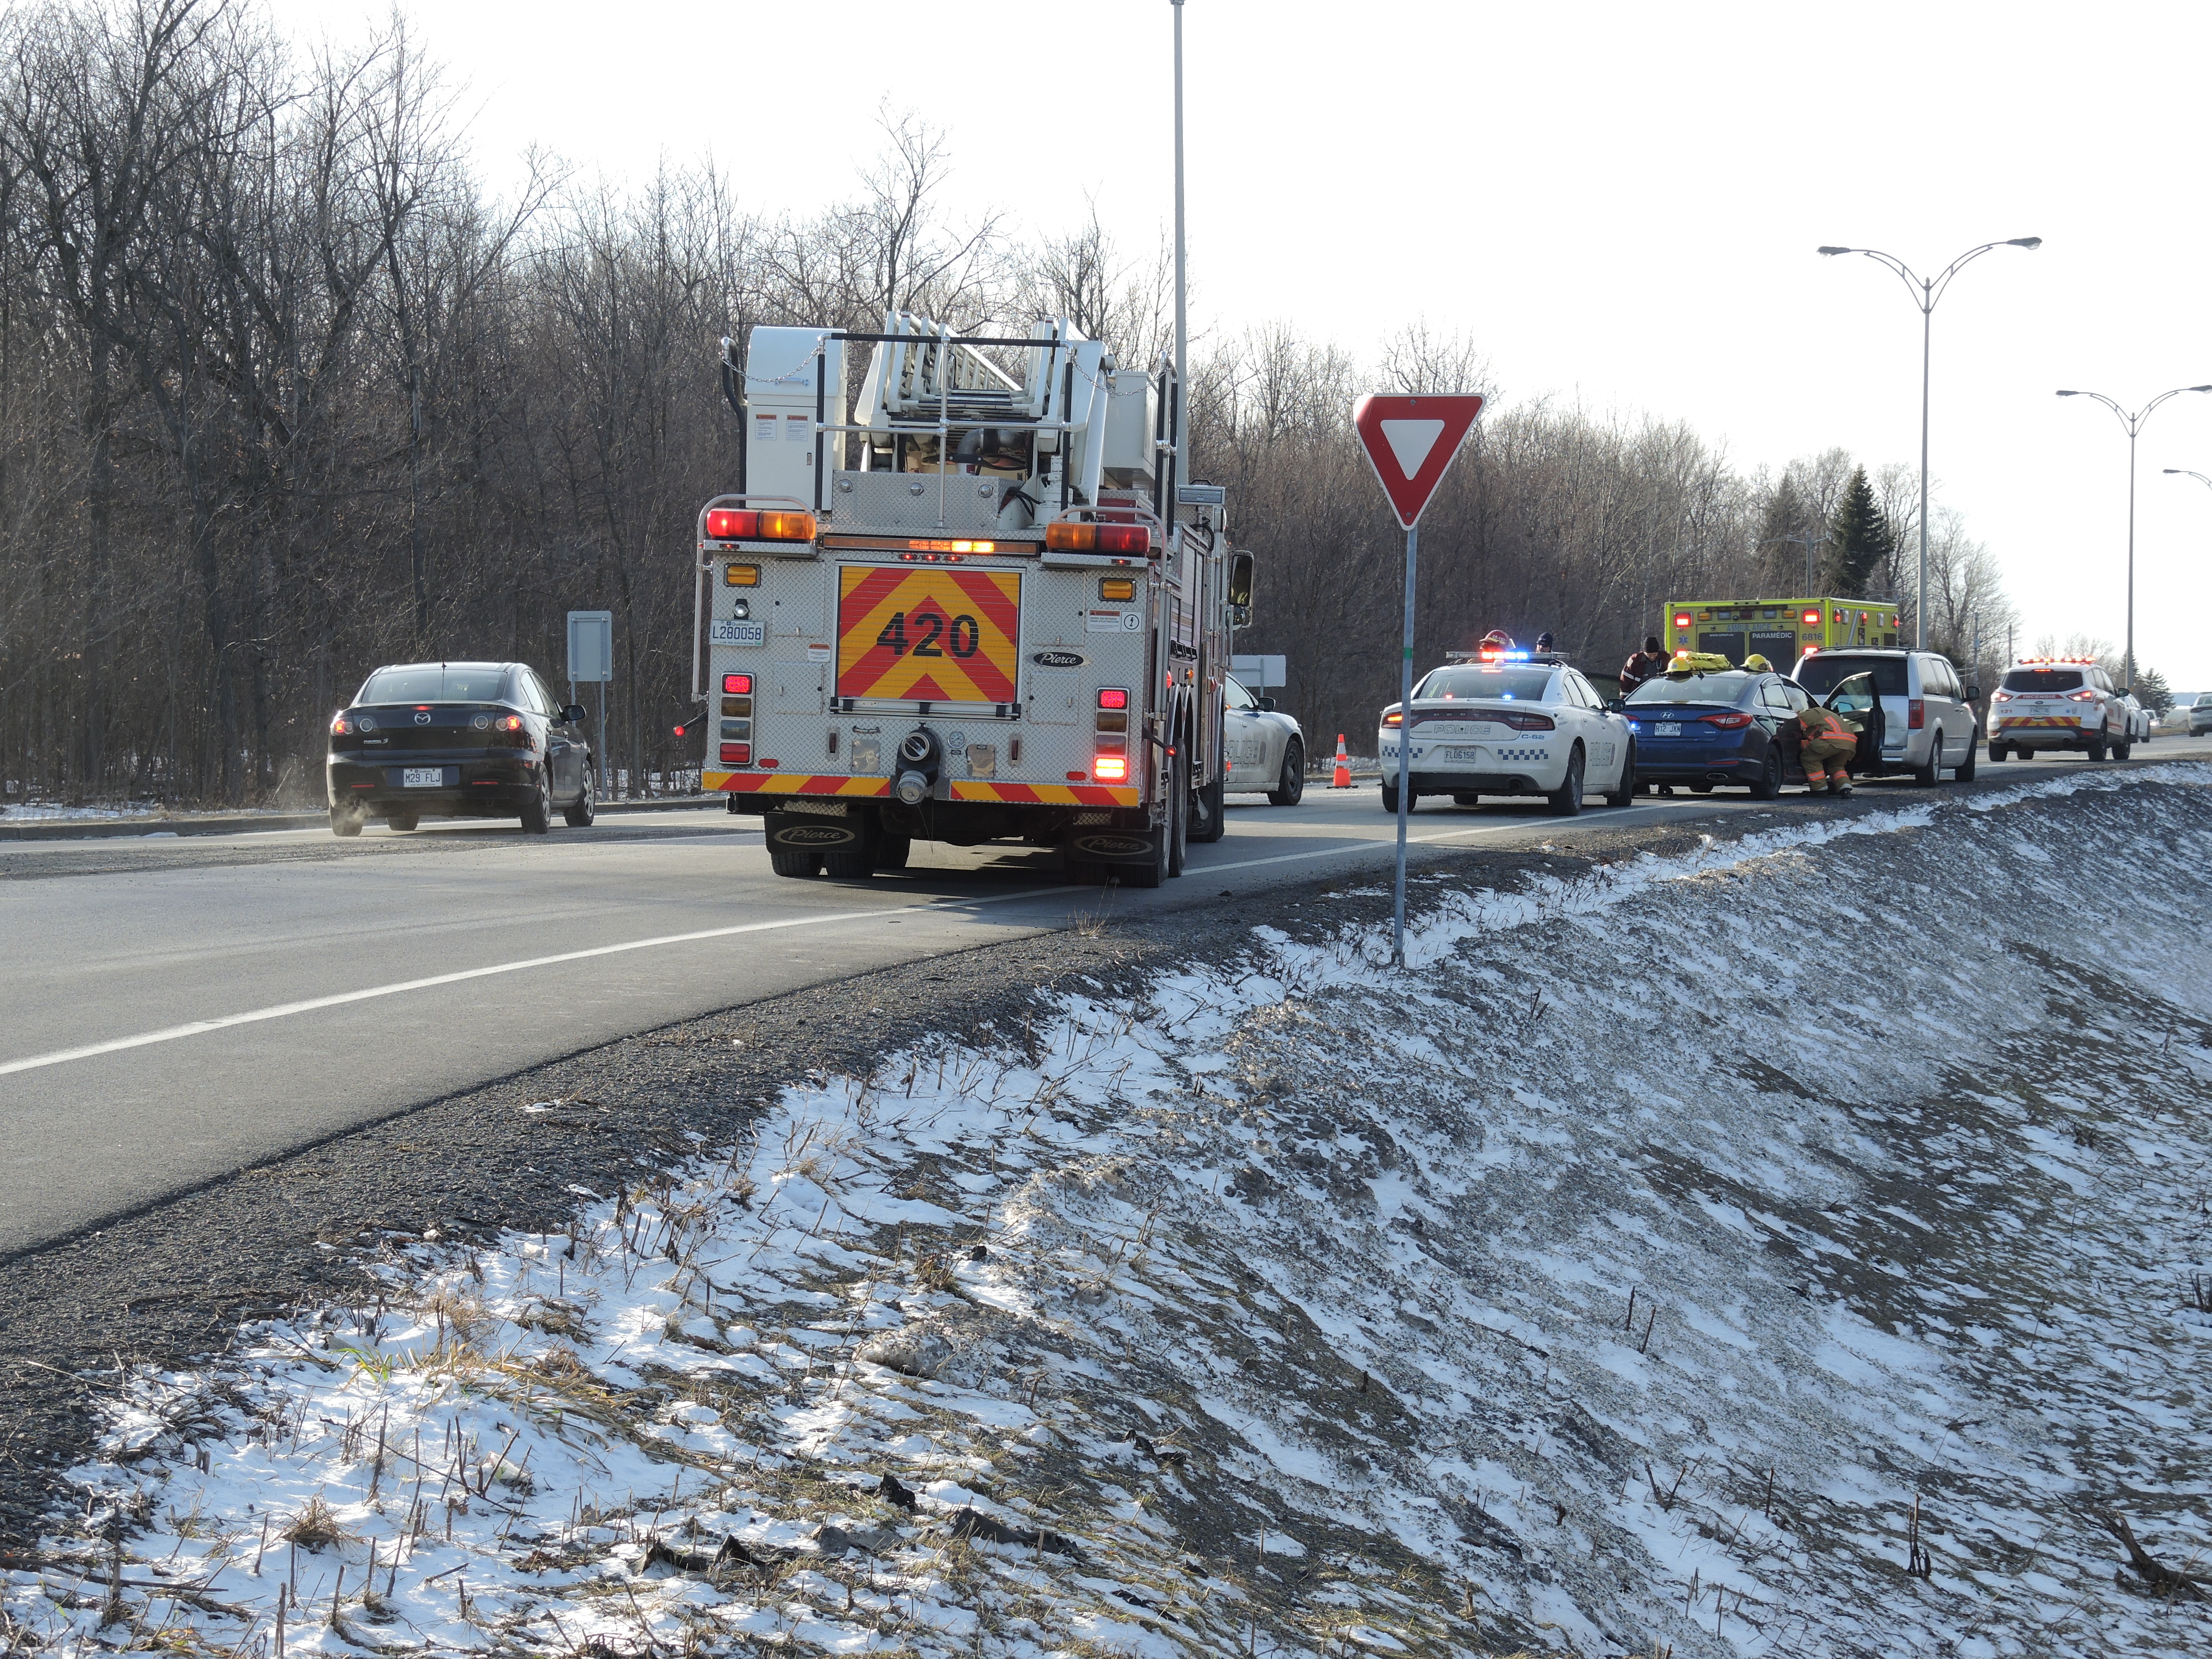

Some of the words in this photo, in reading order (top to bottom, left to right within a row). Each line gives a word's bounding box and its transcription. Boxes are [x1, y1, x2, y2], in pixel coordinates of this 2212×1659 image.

[712, 626, 761, 640] L280058
[1726, 623, 1771, 632] AMBULANCE
[877, 612, 979, 658] 420
[1802, 633, 1823, 641] 6816
[1040, 653, 1077, 664] Pierce
[1434, 724, 1491, 734] POLICE
[405, 773, 420, 783] M29
[425, 773, 440, 782] FLJ
[788, 830, 841, 841] Pierce
[1088, 838, 1139, 849] Pierce
